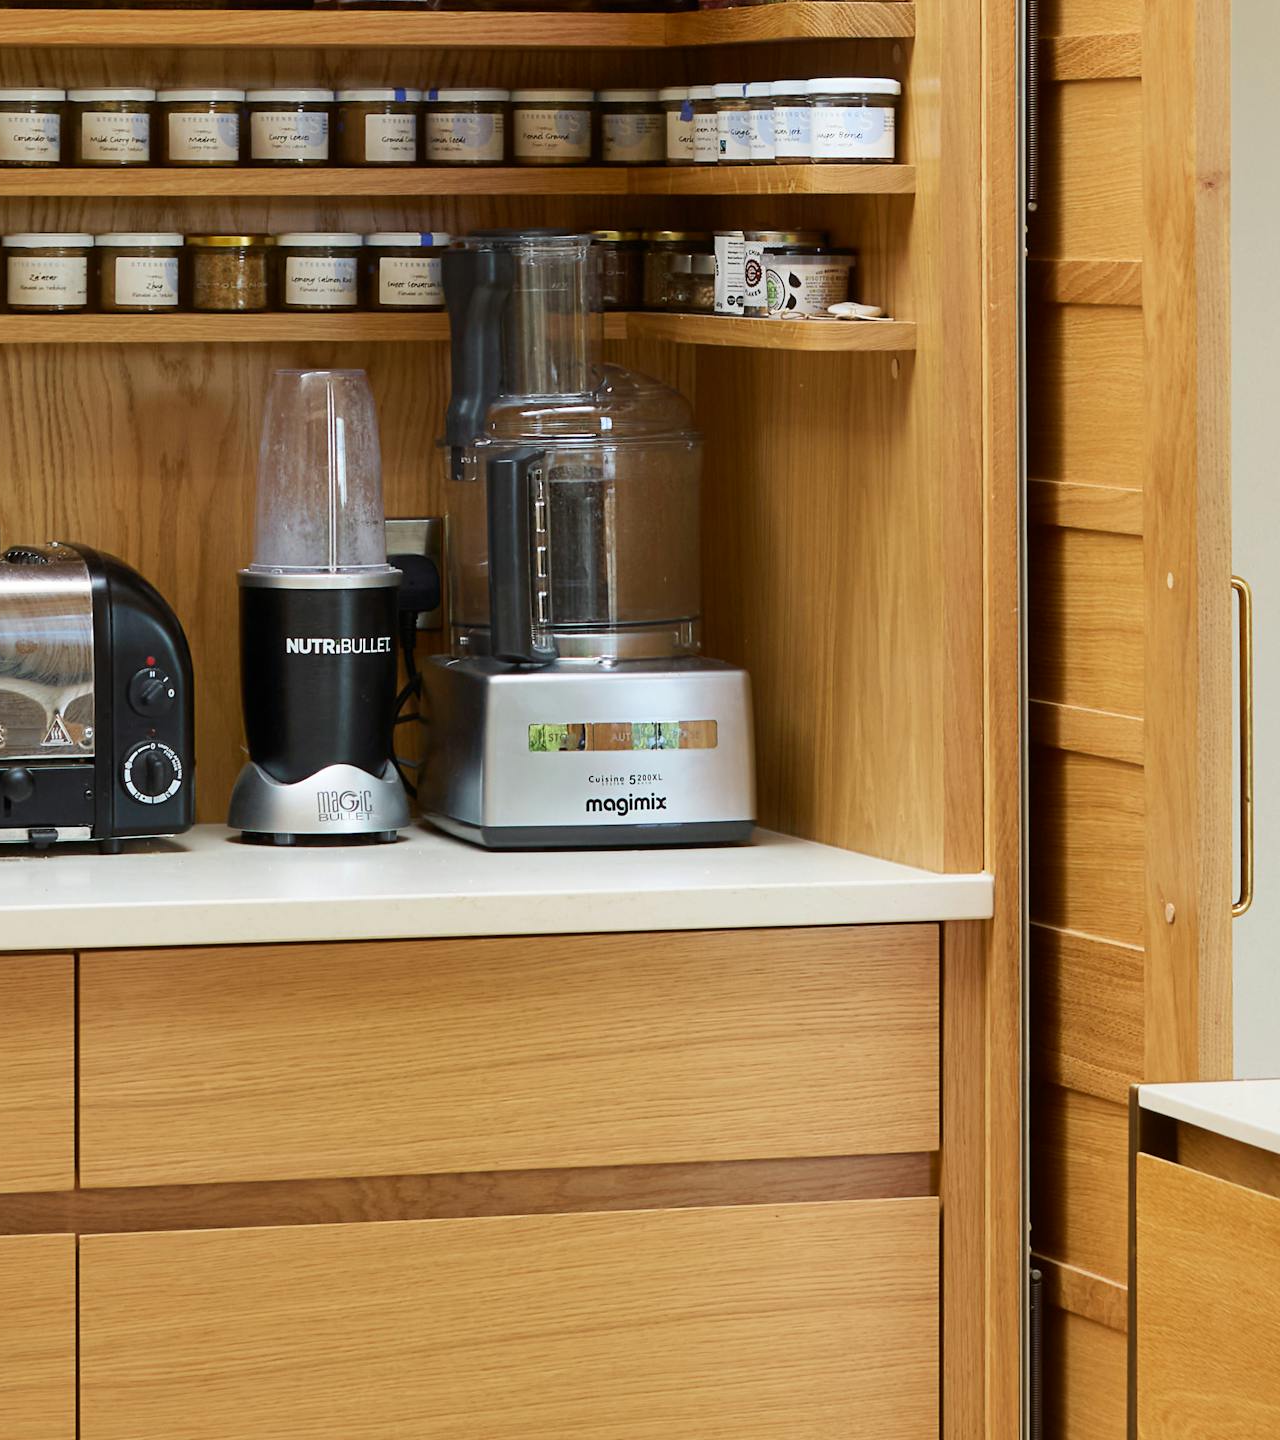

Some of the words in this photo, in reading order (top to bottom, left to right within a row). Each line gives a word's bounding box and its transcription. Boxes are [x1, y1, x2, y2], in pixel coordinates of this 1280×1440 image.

[729, 128, 750, 138] Ginge
[548, 731, 572, 742] STO
[588, 775, 625, 784] Cuisine
[586, 792, 667, 817] magimix
[318, 812, 373, 822] BULLET
